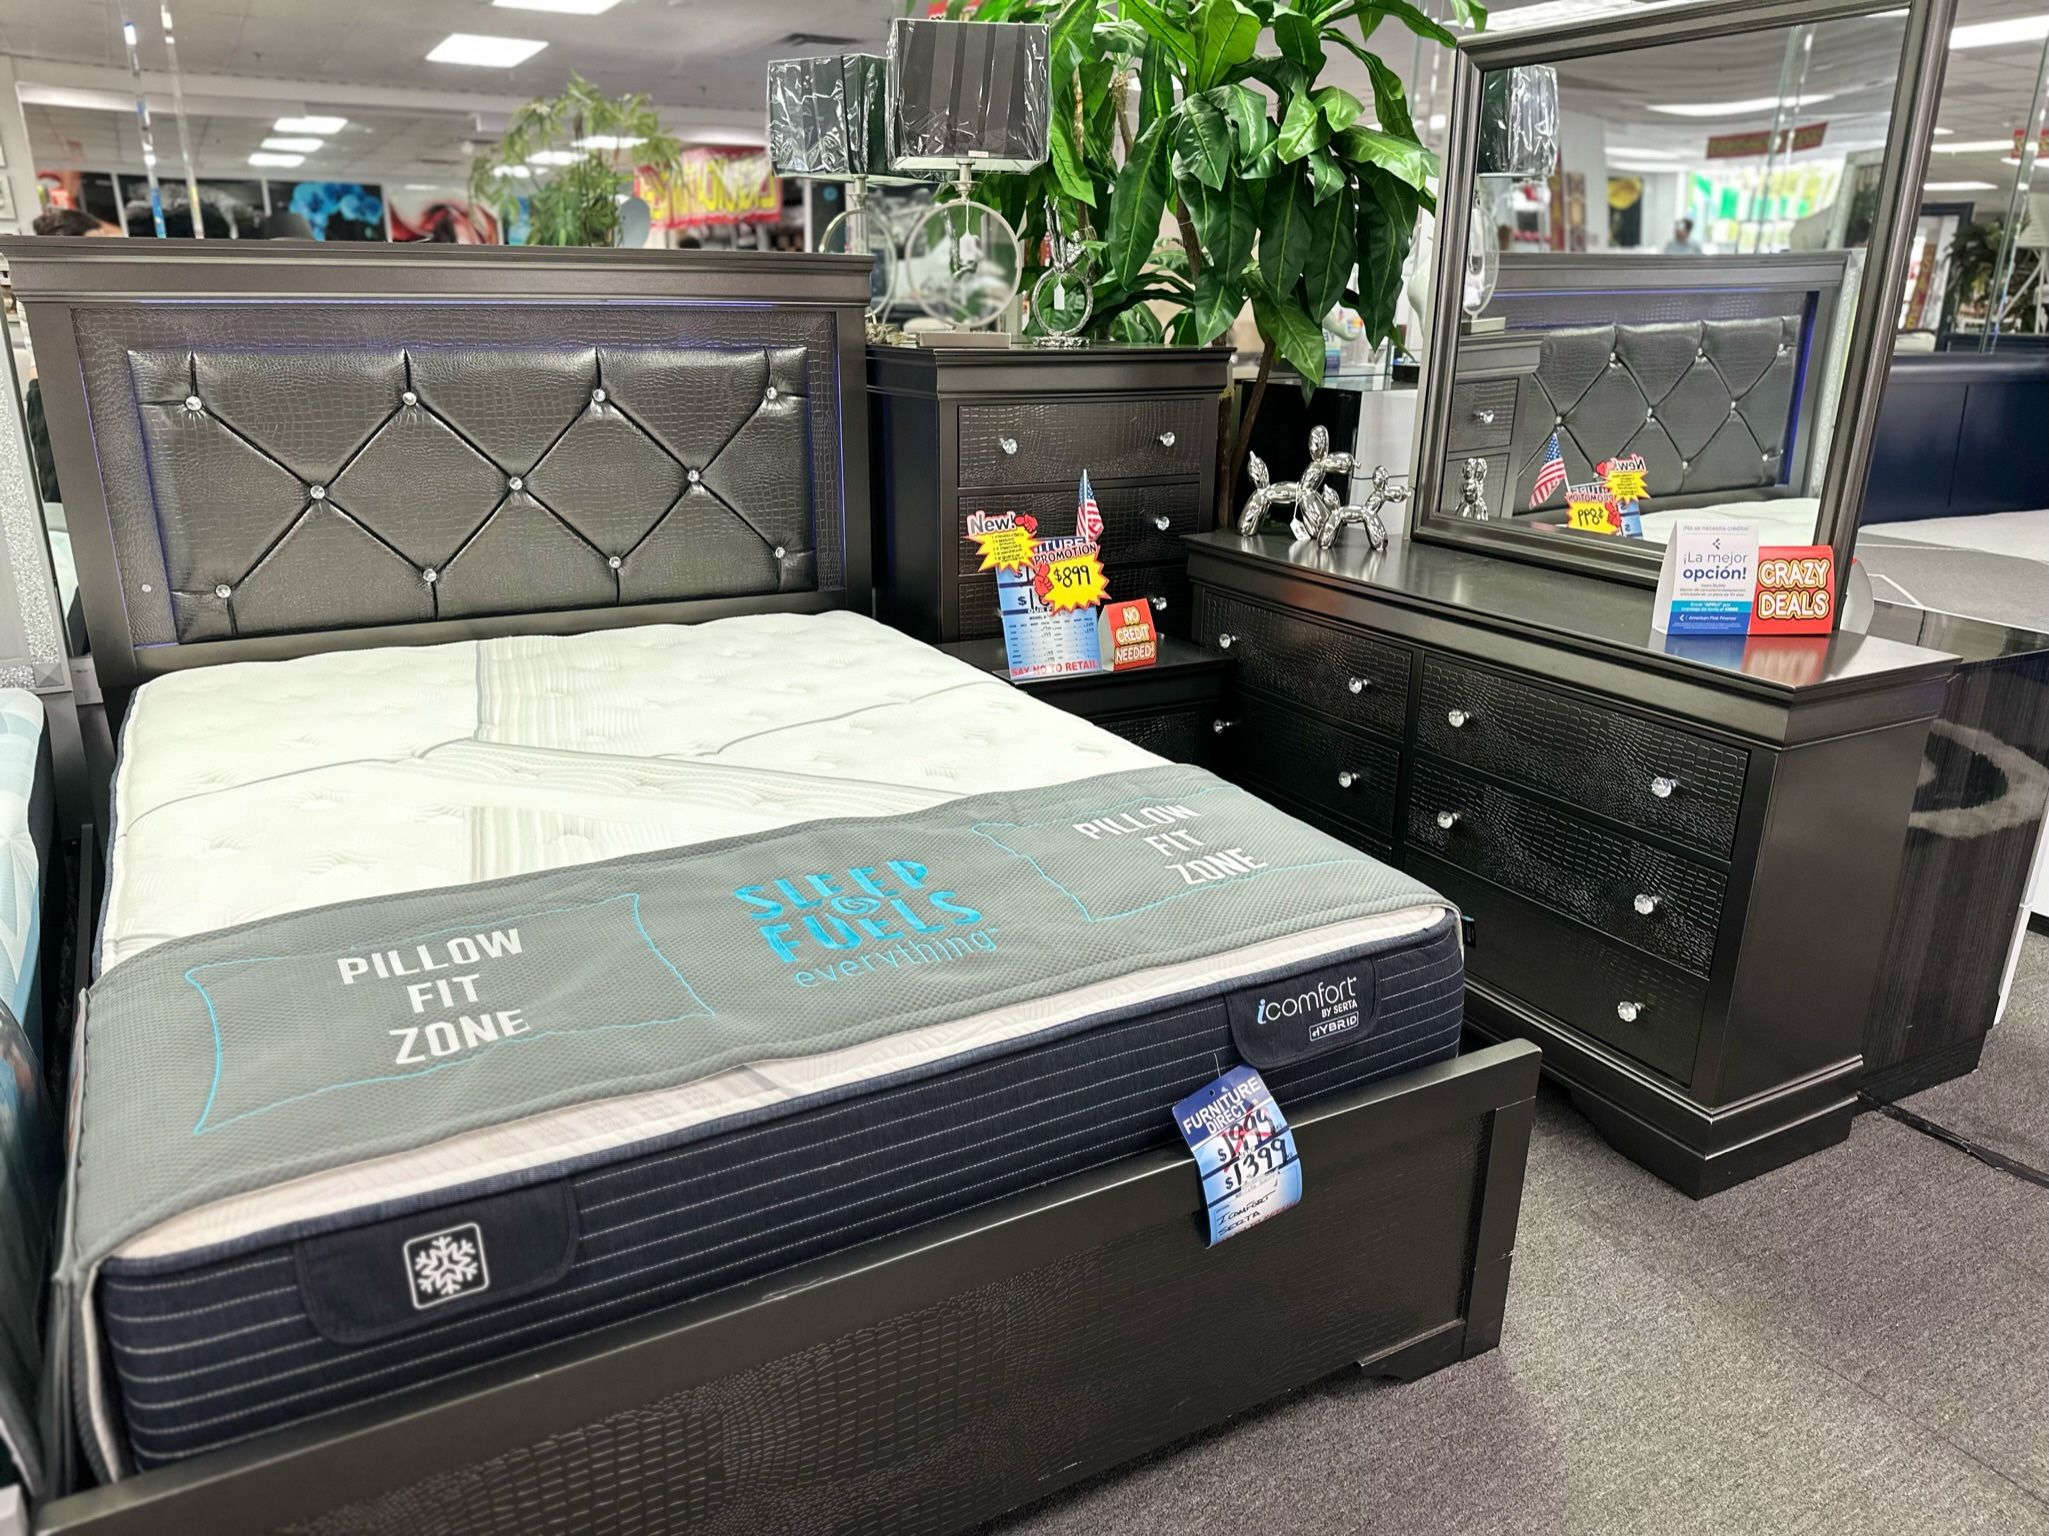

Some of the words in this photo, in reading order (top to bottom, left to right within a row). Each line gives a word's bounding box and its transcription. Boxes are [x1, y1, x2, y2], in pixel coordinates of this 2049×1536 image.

[969, 513, 1016, 535] New!
[1034, 543, 1097, 564] PROMOTION
[1683, 551, 1703, 565] ¡La
[1707, 551, 1748, 568] mejor
[1053, 565, 1092, 589] $899
[1682, 564, 1747, 582] opción!
[1759, 559, 1831, 589] CRAZY
[1122, 606, 1140, 625] NO
[1758, 591, 1830, 619] DEALS
[1116, 623, 1150, 645] CREDIT
[1065, 660, 1098, 673] RETAIL
[1115, 642, 1155, 664] NEEDED!
[1072, 804, 1200, 840] PILLOW
[1142, 828, 1205, 856] FIT
[1164, 847, 1269, 884] ZONE
[733, 859, 929, 920] SLEEP
[758, 890, 982, 963] FUELS
[337, 927, 523, 985] PILLOW
[794, 928, 997, 988] everything
[406, 972, 481, 1014] FIT
[1321, 1007, 1332, 1018] BY
[1333, 999, 1358, 1014] SERTA
[388, 1008, 531, 1065] ZONE
[1311, 1014, 1358, 1038] HYBRID
[1182, 1076, 1262, 1135] FURNITURE
[1205, 1101, 1248, 1136] DIRECT
